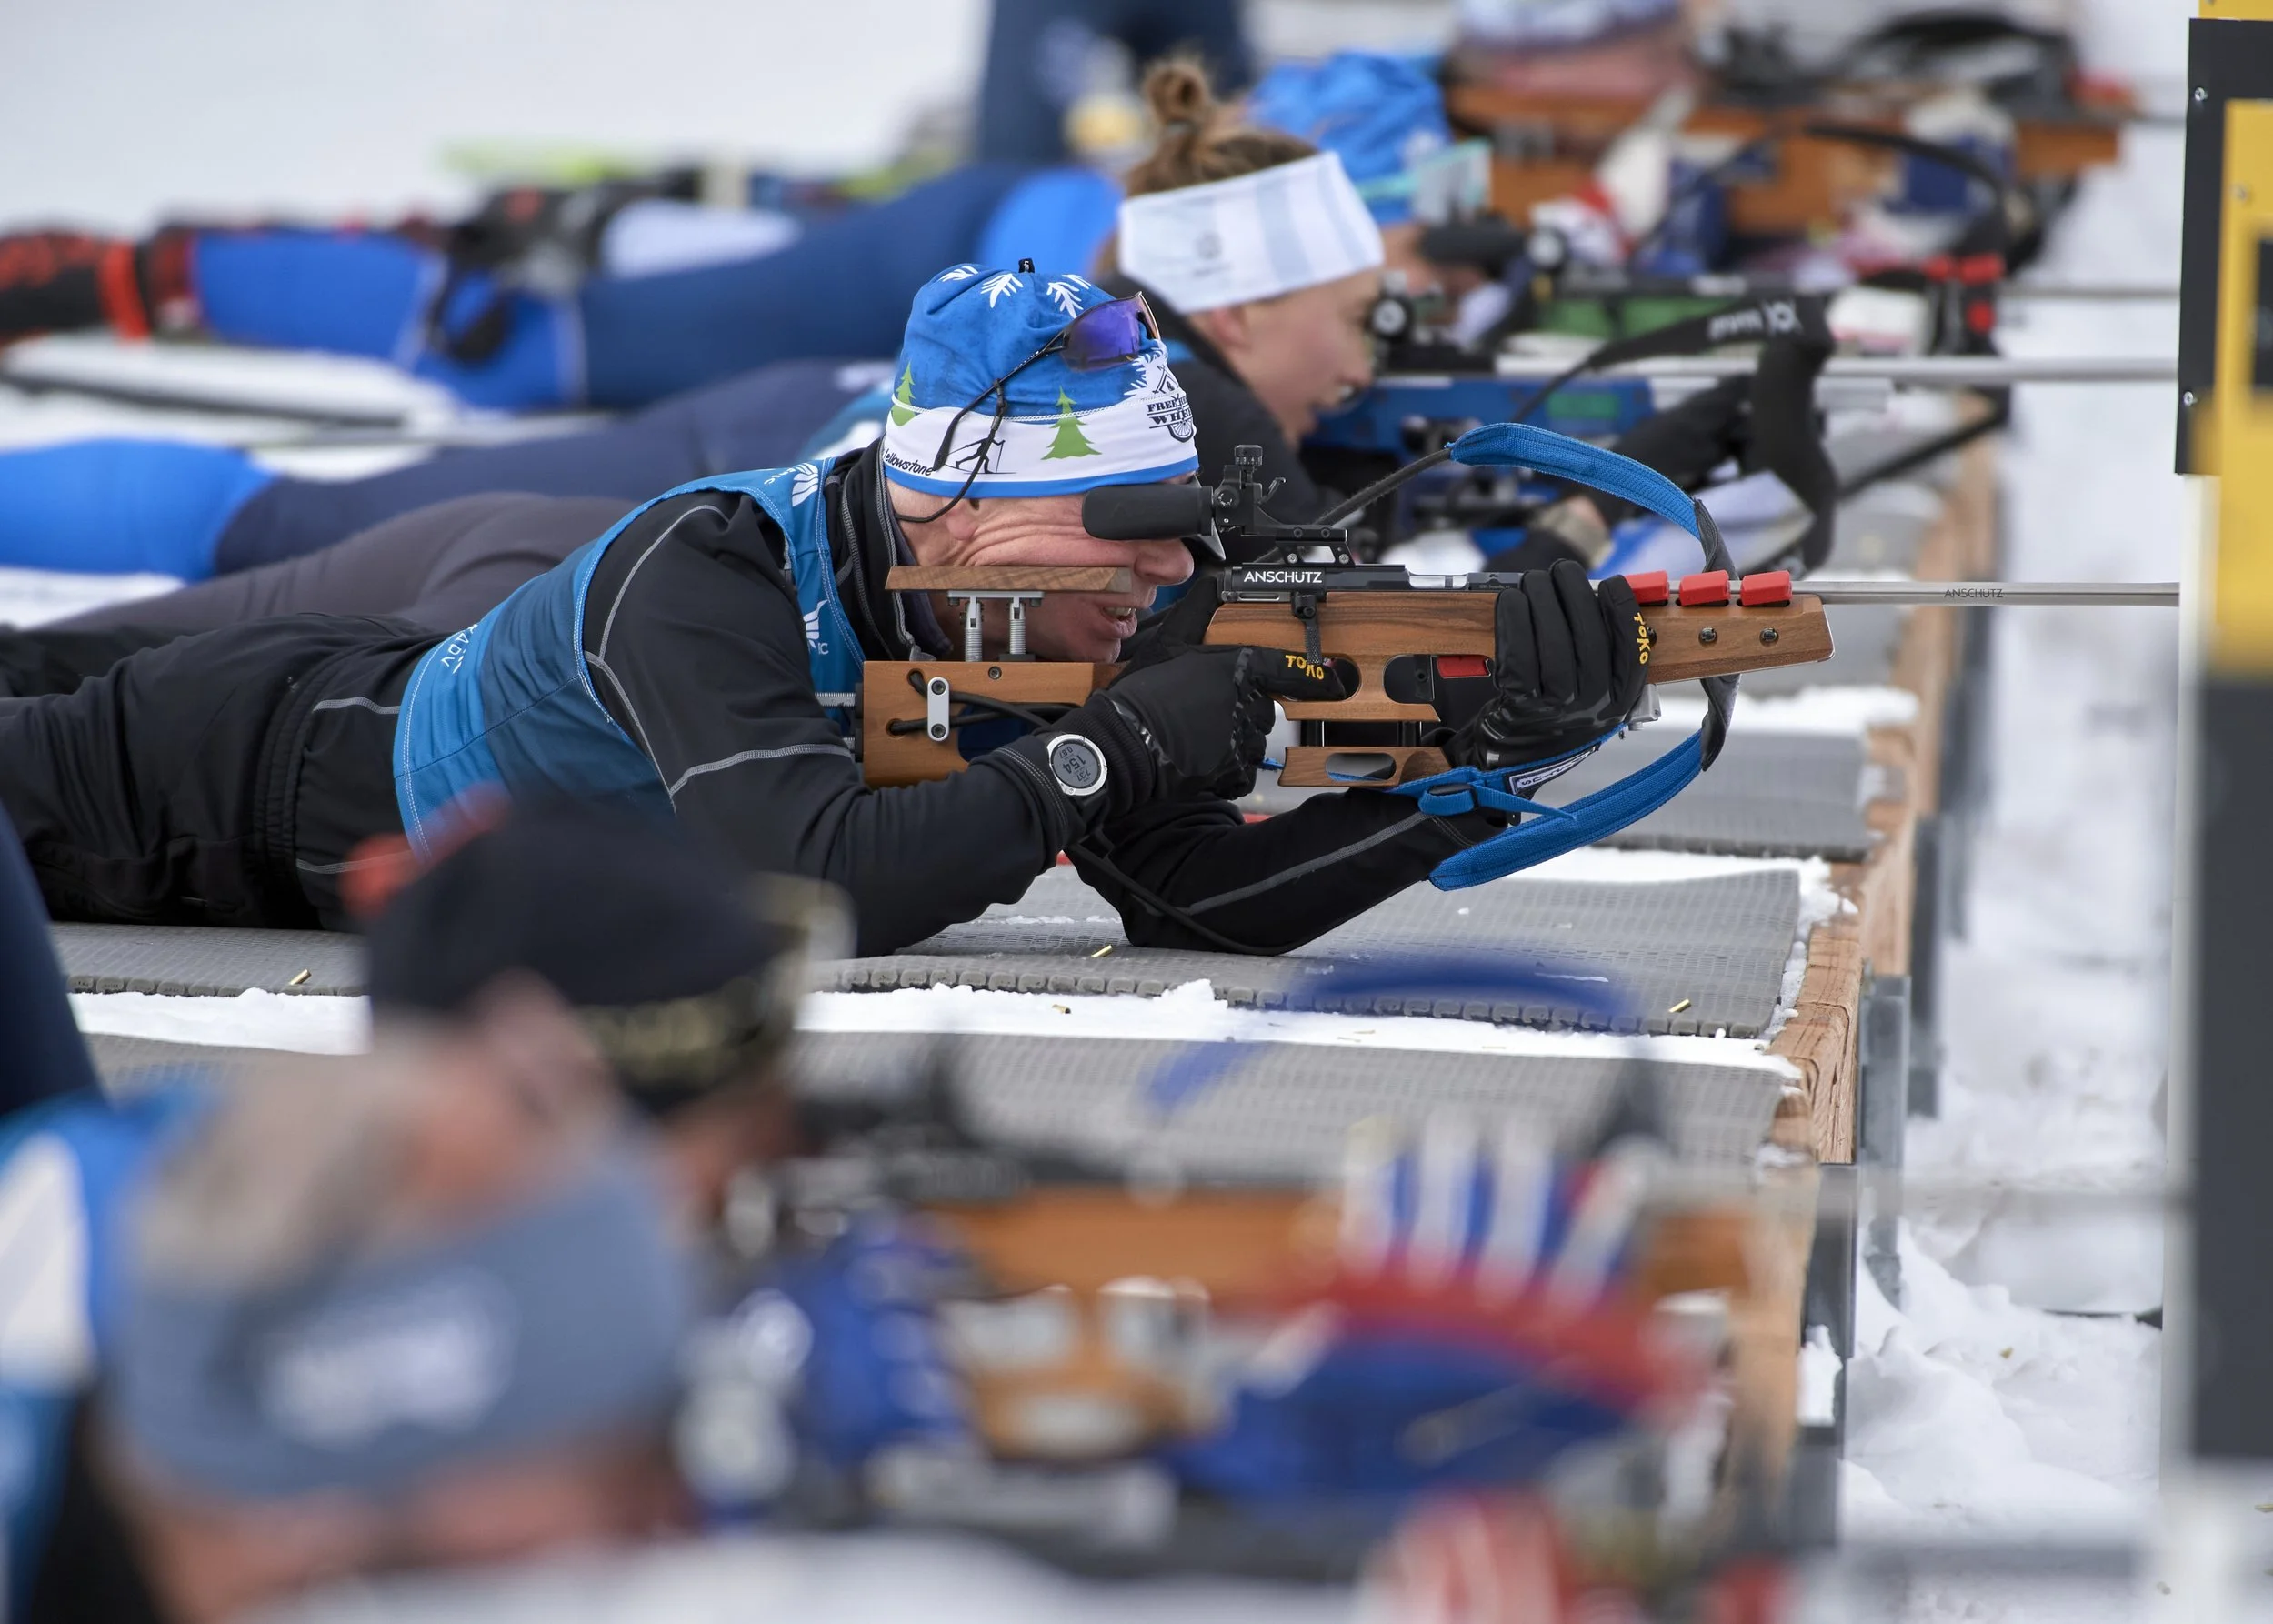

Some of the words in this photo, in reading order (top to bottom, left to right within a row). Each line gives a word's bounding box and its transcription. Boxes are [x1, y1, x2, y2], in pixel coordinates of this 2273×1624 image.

[1243, 570, 1323, 584] ANSCHÜTZ
[1633, 611, 1651, 665] TOKO
[1285, 654, 1325, 680] TOKO
[1062, 755, 1086, 775] 154
